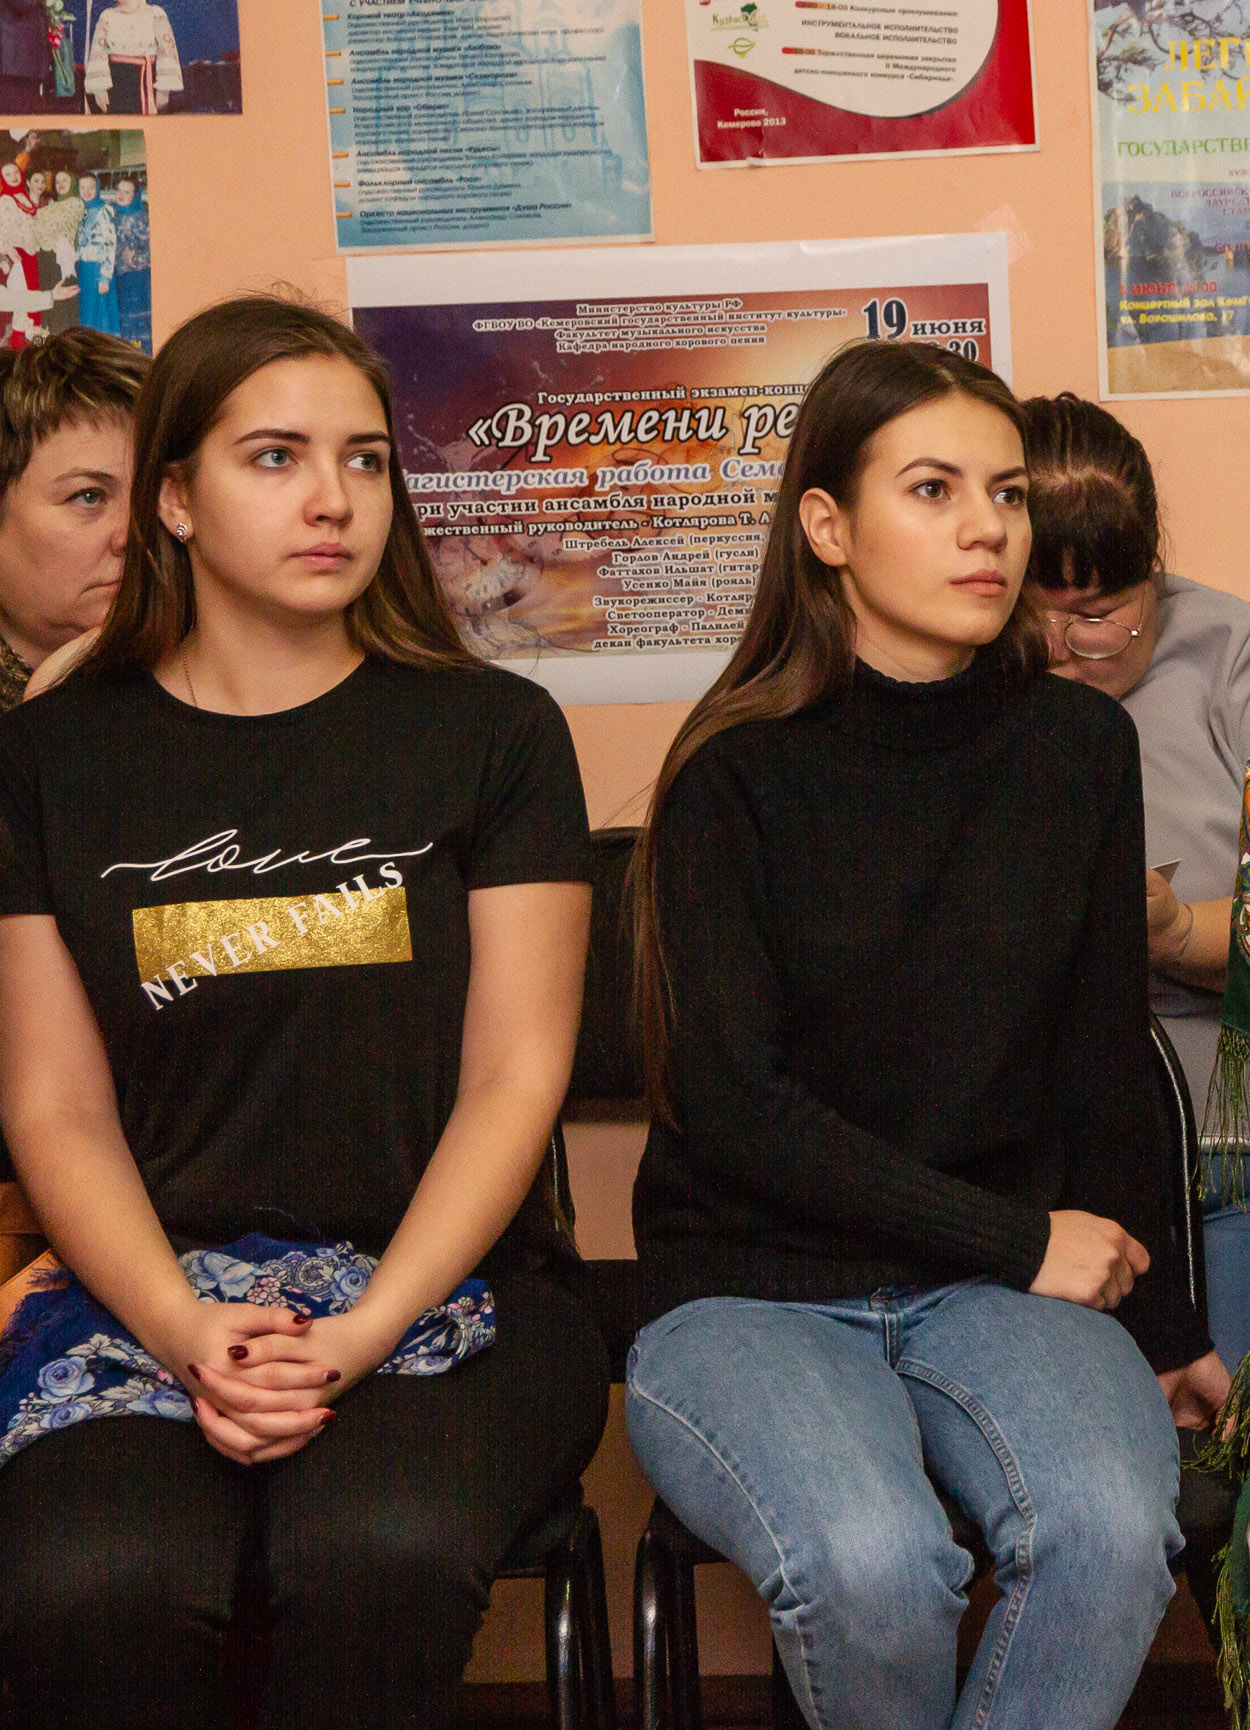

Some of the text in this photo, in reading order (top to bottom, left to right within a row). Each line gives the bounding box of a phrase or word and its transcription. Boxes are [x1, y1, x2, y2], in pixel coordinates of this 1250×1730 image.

[763, 116, 787, 127] 2013
[1131, 281, 1177, 296] ИЮНЯ
[578, 299, 742, 315] Министерство культуры РФ
[474, 308, 847, 331] ФГБОУ ВО «Кемеровский государственный институт культуры»
[863, 298, 985, 340] 19 июня
[555, 324, 766, 341] Факультет музыкального искусства
[558, 335, 765, 354] Кафедра народного хорового пения
[537, 386, 687, 406] Государственный
[467, 402, 800, 463] «Времени ре
[402, 468, 587, 495] агистерская
[597, 457, 709, 490] работа
[416, 502, 443, 520] ри
[449, 499, 537, 520] участии
[543, 493, 646, 512] ансамбля
[653, 488, 757, 513] народной
[423, 511, 756, 538] жественный руководитель Котлярова Т.
[563, 536, 629, 551] Штребель
[632, 536, 685, 549] Алексей
[613, 547, 760, 565] Горлов Андрей (гусли)
[598, 562, 761, 578] Фаттахов Ильшат (гитар
[623, 575, 757, 592] Усенко Майя (рояль)
[593, 592, 755, 609] Звукорежиссер Котляр
[606, 608, 706, 622] Светооператор
[608, 622, 679, 637] Хореограф
[593, 639, 632, 651] декан
[636, 635, 712, 650] факультета
[101, 829, 434, 881] love
[140, 861, 404, 1011] NEVER FAILS
